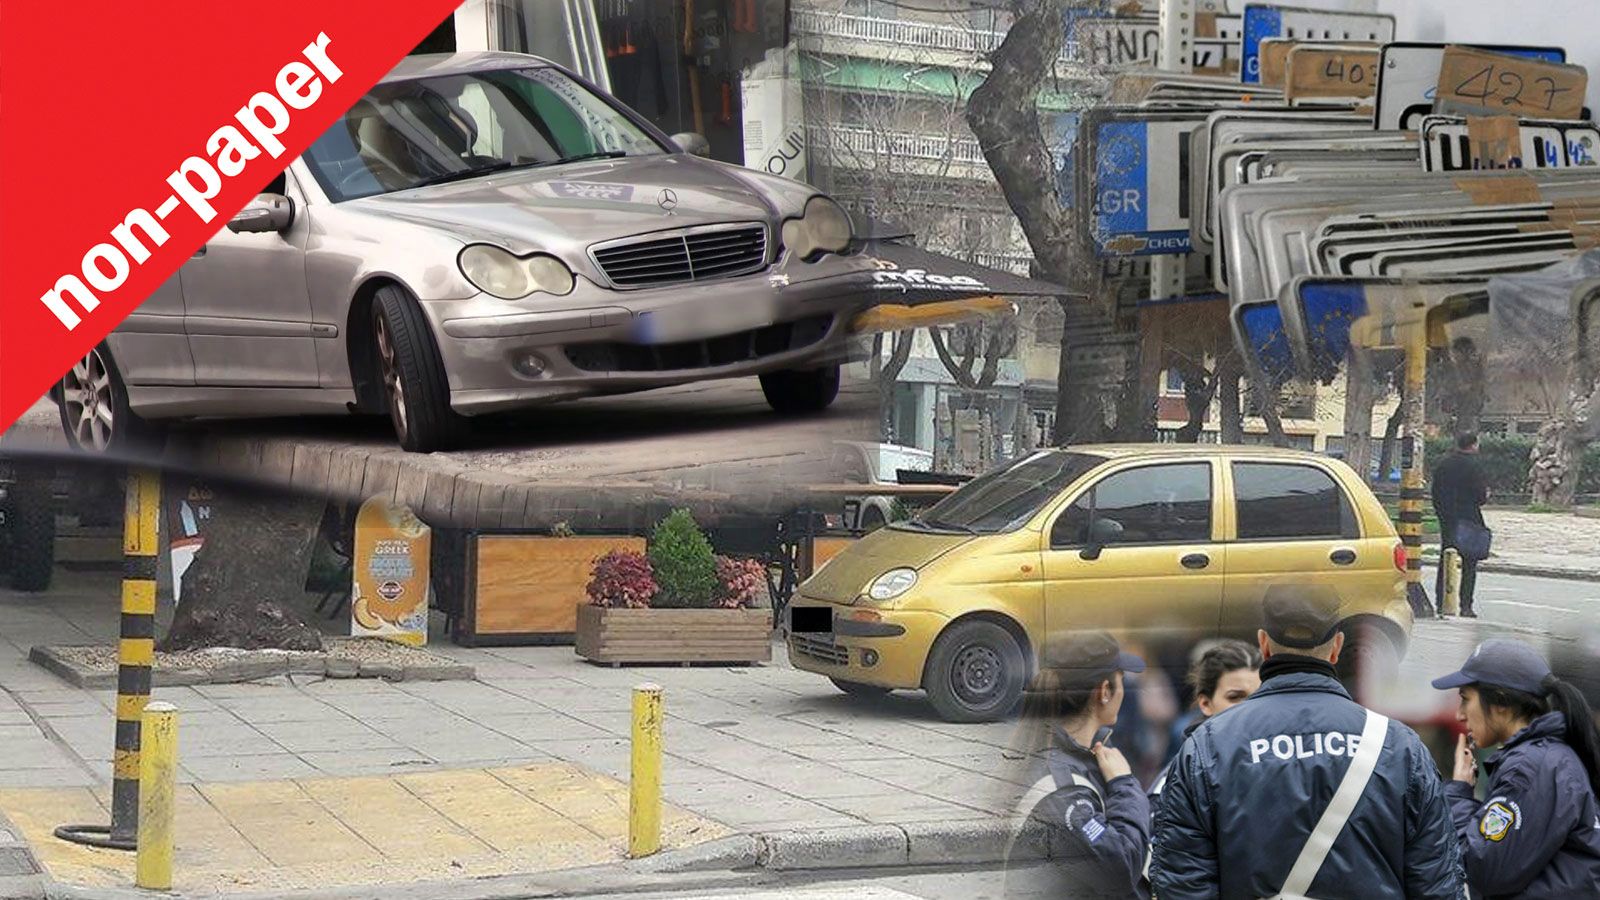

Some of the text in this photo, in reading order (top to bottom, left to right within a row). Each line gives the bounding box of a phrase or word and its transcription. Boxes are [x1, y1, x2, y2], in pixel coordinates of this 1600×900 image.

[1455, 64, 1572, 111] 427
[1101, 189, 1141, 213] GR
[1250, 731, 1362, 763] POLICE
